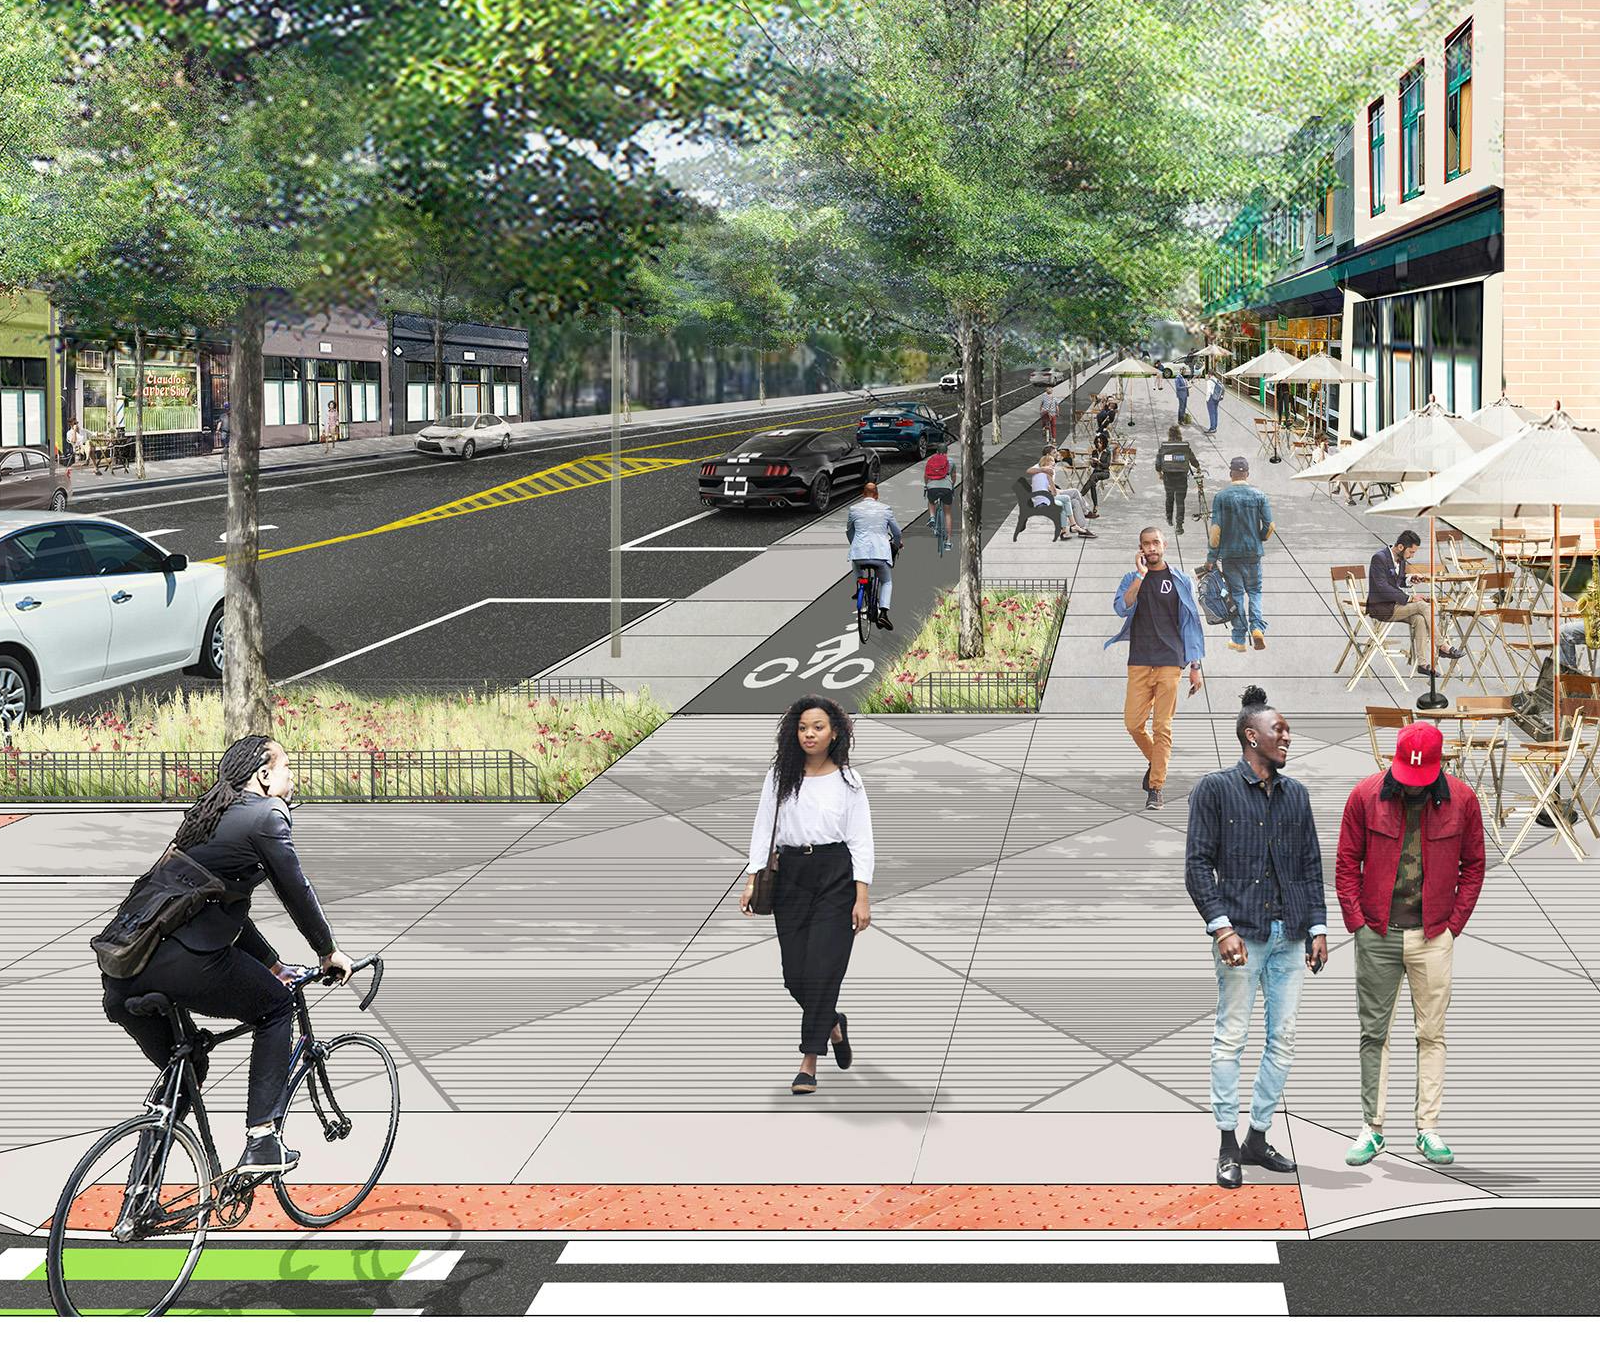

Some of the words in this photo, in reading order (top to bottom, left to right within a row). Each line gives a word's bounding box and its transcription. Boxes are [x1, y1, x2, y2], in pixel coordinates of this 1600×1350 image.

[133, 385, 170, 397] arber
[170, 385, 191, 399] Shop
[1410, 749, 1423, 766] H
